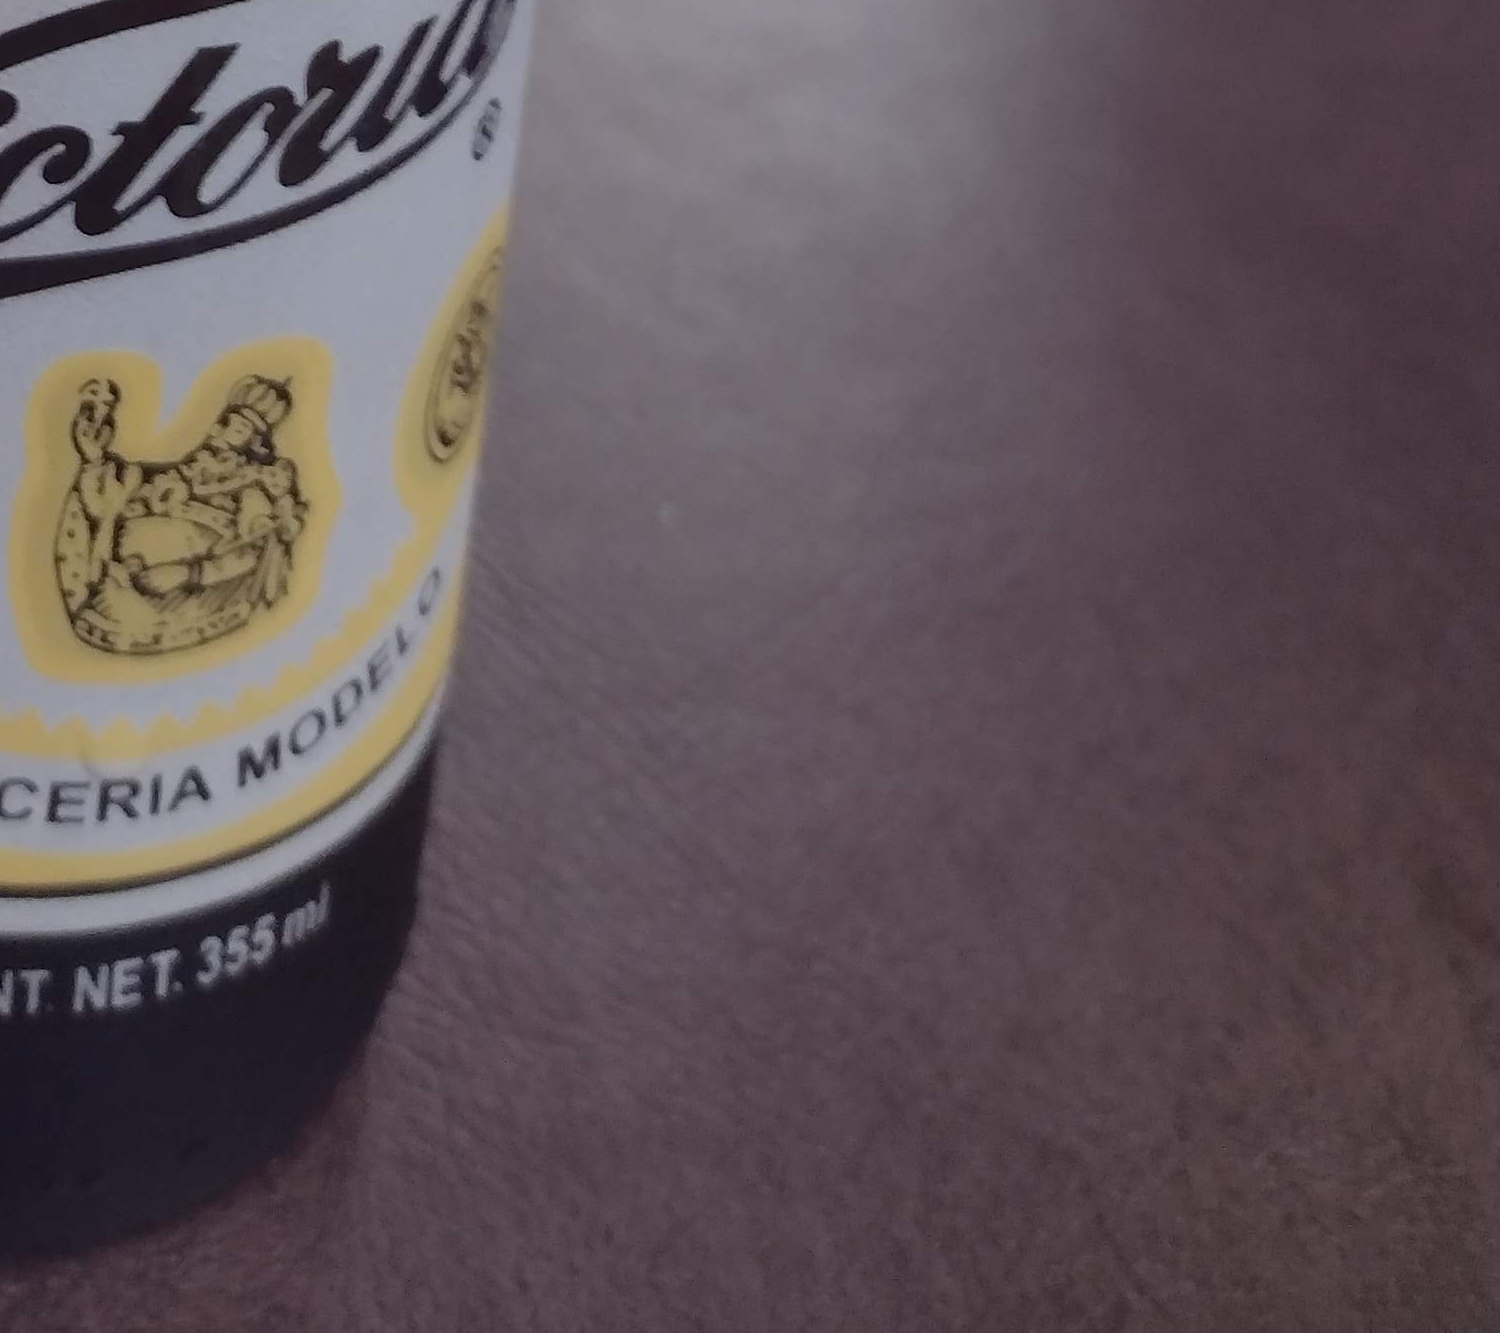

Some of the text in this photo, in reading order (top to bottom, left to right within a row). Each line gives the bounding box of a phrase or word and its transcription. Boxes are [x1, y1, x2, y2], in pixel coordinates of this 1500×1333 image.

[237, 566, 440, 787] MODELO
[197, 913, 275, 987] 355
[282, 881, 330, 947] ml
